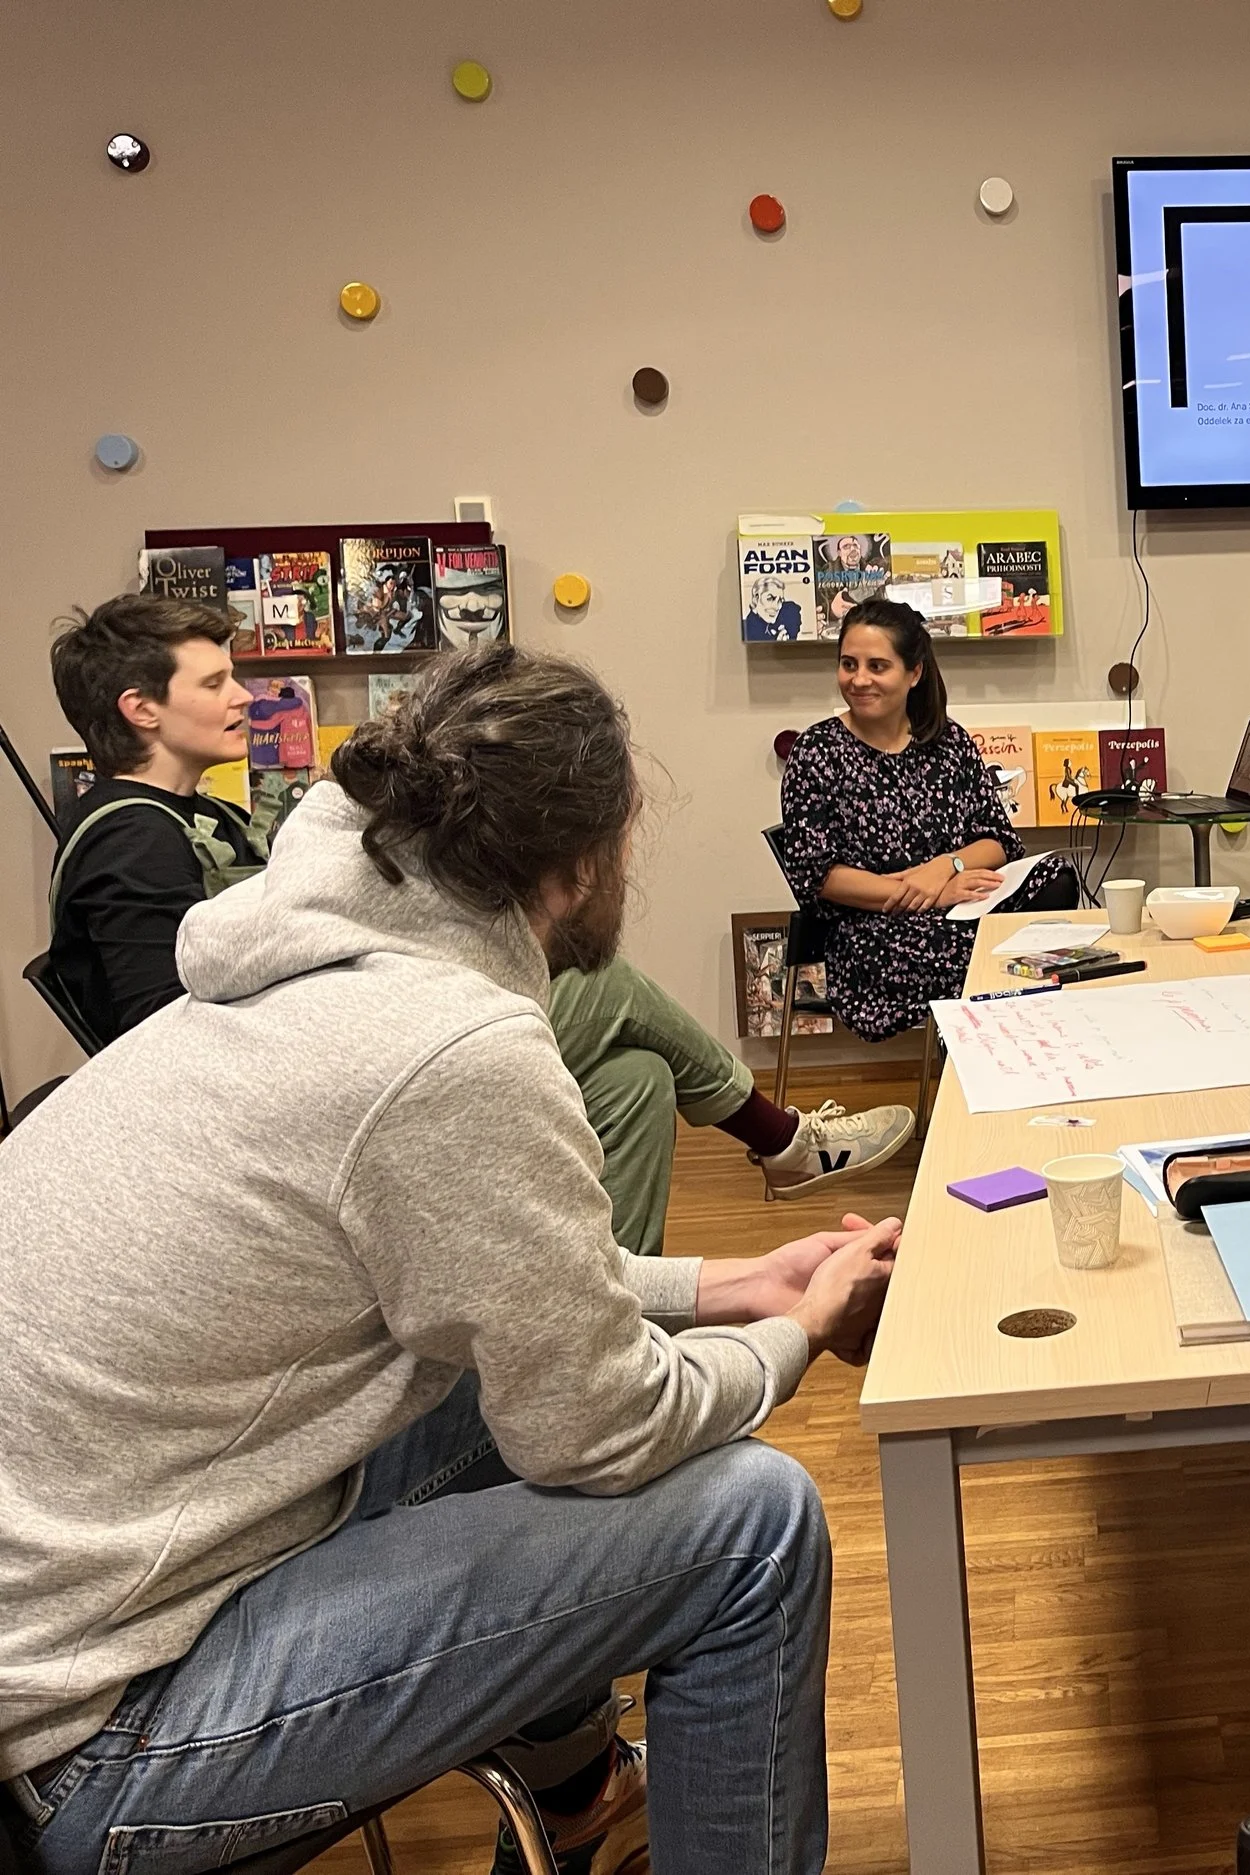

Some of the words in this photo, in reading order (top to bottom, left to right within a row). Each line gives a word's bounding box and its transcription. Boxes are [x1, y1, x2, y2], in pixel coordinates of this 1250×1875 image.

[1197, 402, 1216, 412] Doc.
[1217, 402, 1229, 411] dr.
[1230, 402, 1247, 411] Ana
[1197, 416, 1232, 426] Oddelek
[744, 549, 809, 562] ALAN
[986, 551, 1041, 564] ARABEC
[157, 556, 212, 579] Oliver
[743, 562, 811, 574] FORD
[987, 564, 1041, 572] PRIHODNOSTI
[155, 578, 218, 599] Twist
[272, 604, 288, 618] M
[1108, 739, 1160, 751] Perzepolis
